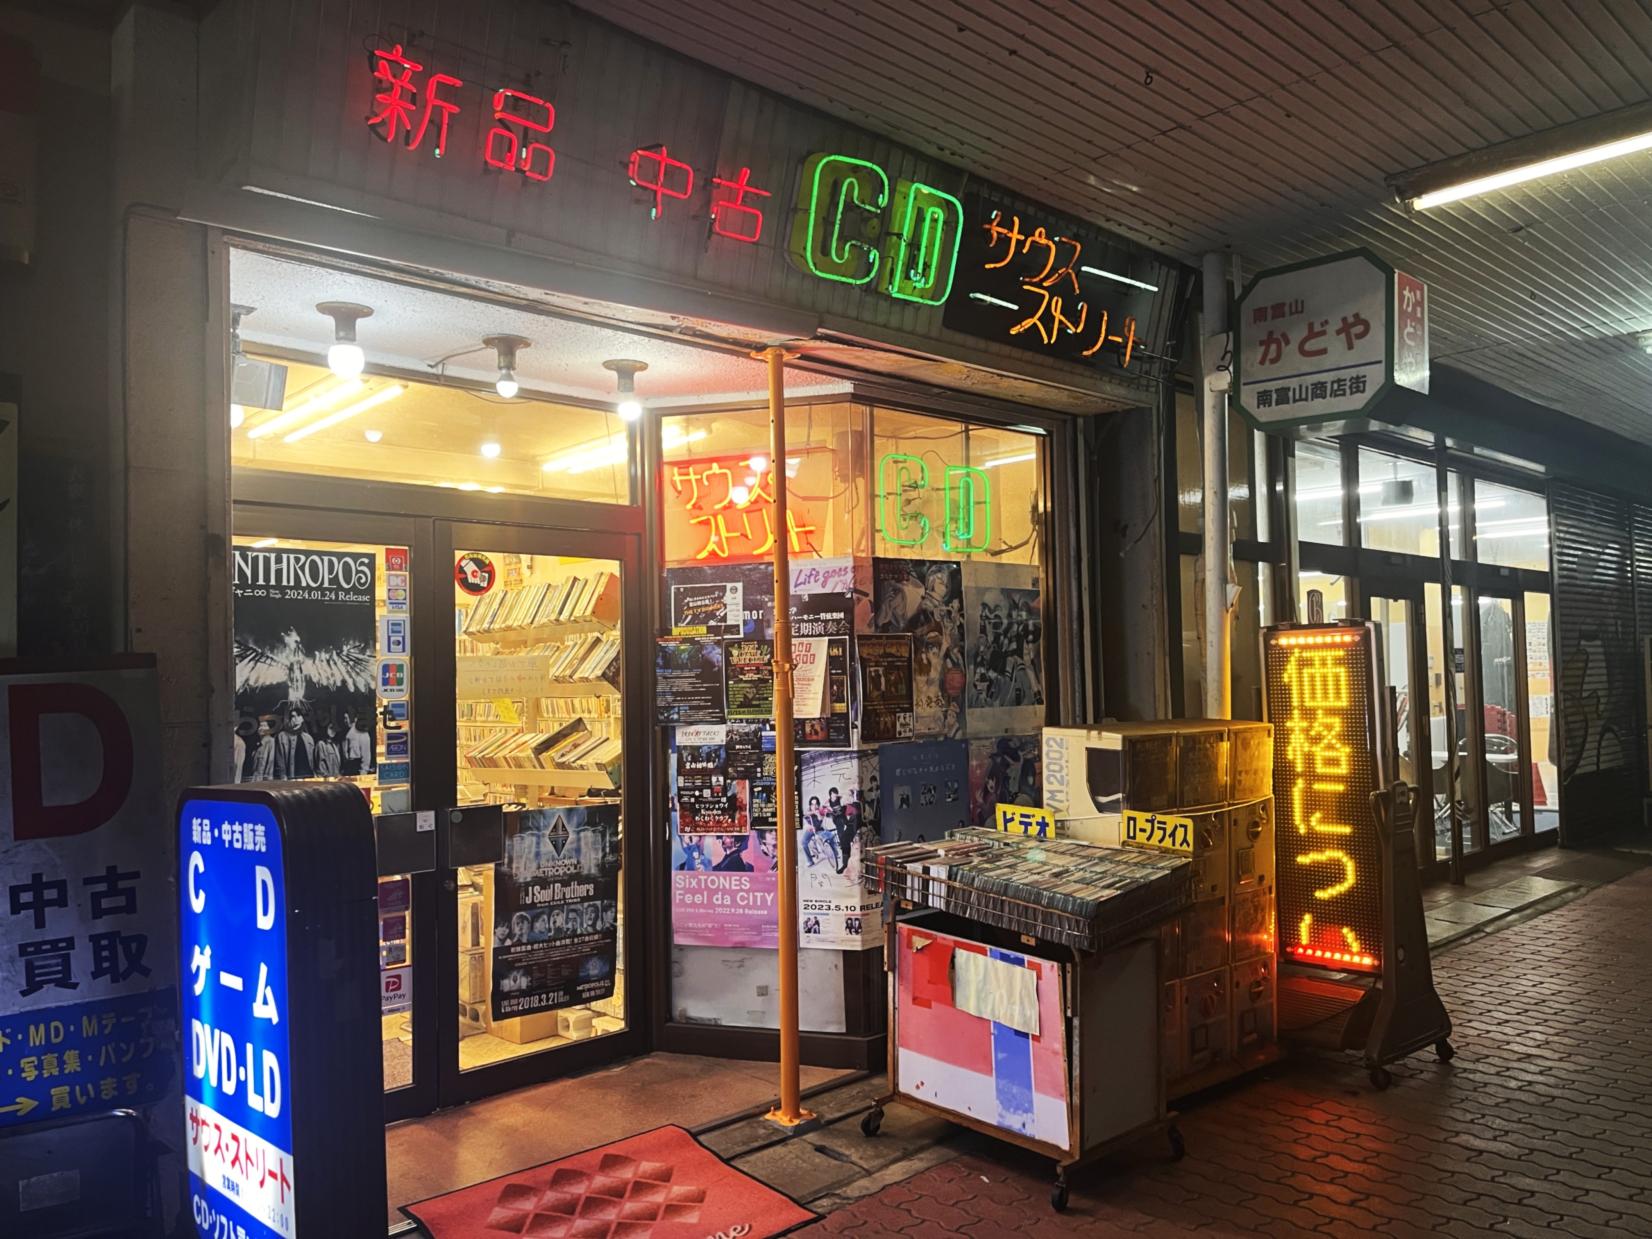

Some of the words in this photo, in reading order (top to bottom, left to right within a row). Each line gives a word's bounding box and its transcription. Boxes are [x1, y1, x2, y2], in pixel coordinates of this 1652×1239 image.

[368, 44, 555, 182] 新品
[629, 145, 772, 243] 中古
[806, 154, 963, 306] CD
[982, 210, 1081, 295] サウス
[1009, 285, 1146, 369] ストリート
[1253, 299, 1305, 324] 南富山
[1258, 311, 1371, 366] かどや
[1256, 374, 1367, 410] 南富山商店街
[672, 461, 774, 509] サウス
[880, 453, 990, 553] CD
[285, 589, 336, 600] 2024.01.24
[339, 591, 371, 601] Release
[8, 683, 134, 842] D
[192, 817, 267, 852] 新品・中古販売
[1126, 814, 1190, 849] ロープライス
[9, 865, 141, 930] 中古
[533, 883, 554, 903] Soul
[554, 880, 594, 900] Brothers
[675, 875, 750, 890] SixTONES
[675, 891, 708, 905] Feel
[713, 894, 731, 905] da
[736, 892, 775, 906] CITY
[803, 904, 857, 912] 2023.5.10
[18, 930, 152, 998] 買取
[191, 944, 279, 1025] ゲーム
